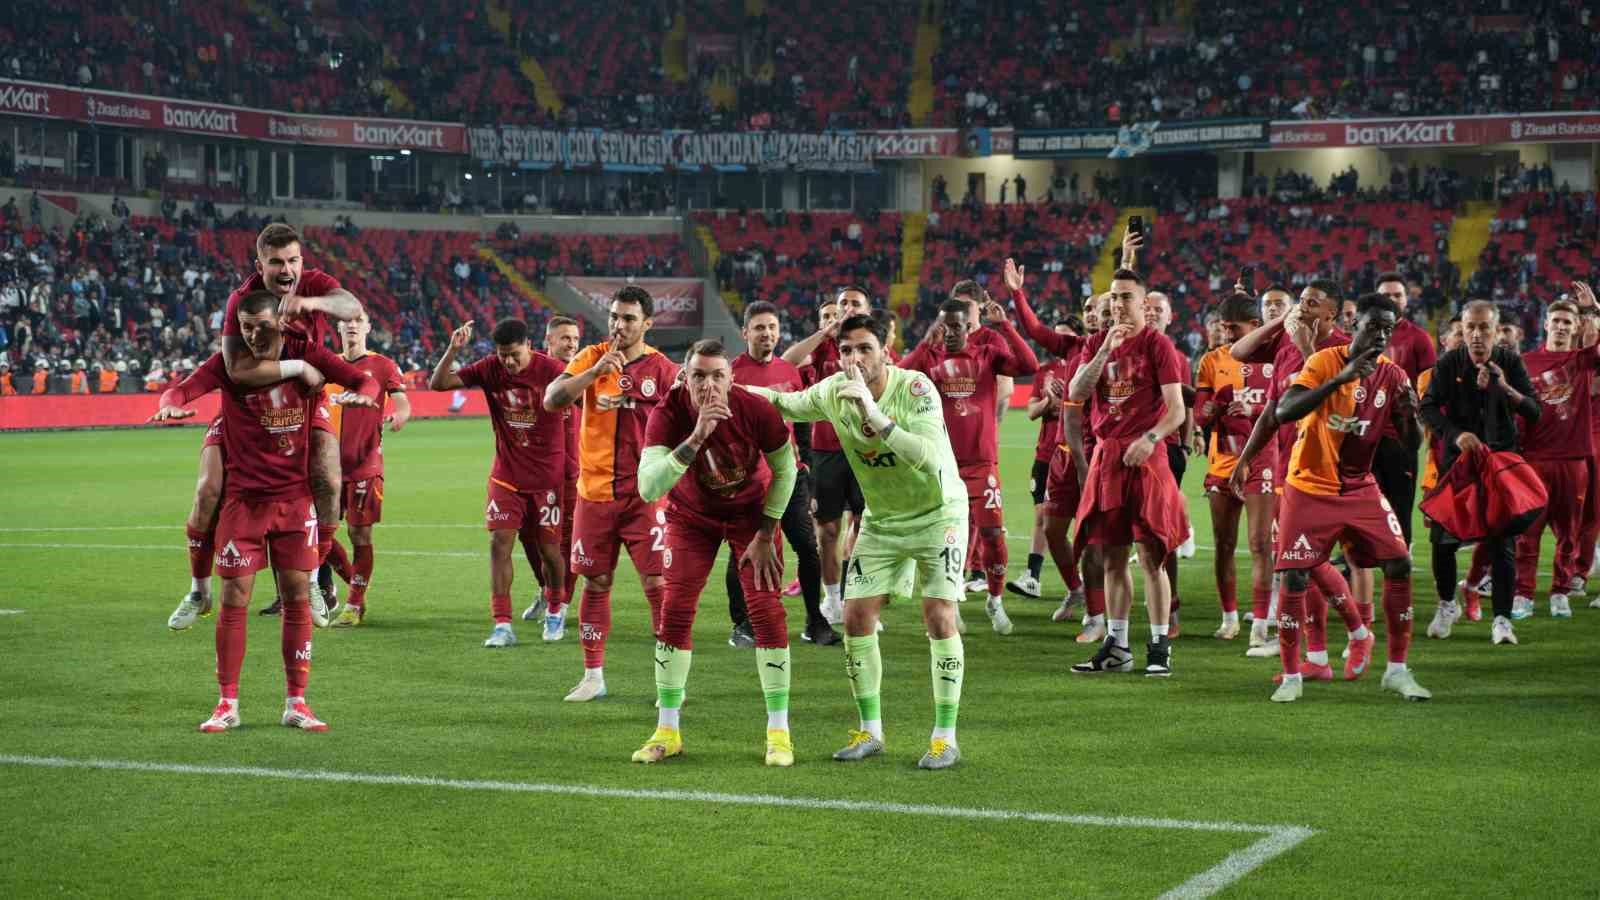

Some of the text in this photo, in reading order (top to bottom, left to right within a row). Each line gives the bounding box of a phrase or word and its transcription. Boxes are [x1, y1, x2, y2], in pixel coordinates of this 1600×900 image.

[983, 488, 1002, 509] 26
[540, 506, 560, 525] 20
[1387, 513, 1402, 536] 6
[940, 547, 961, 573] 19
